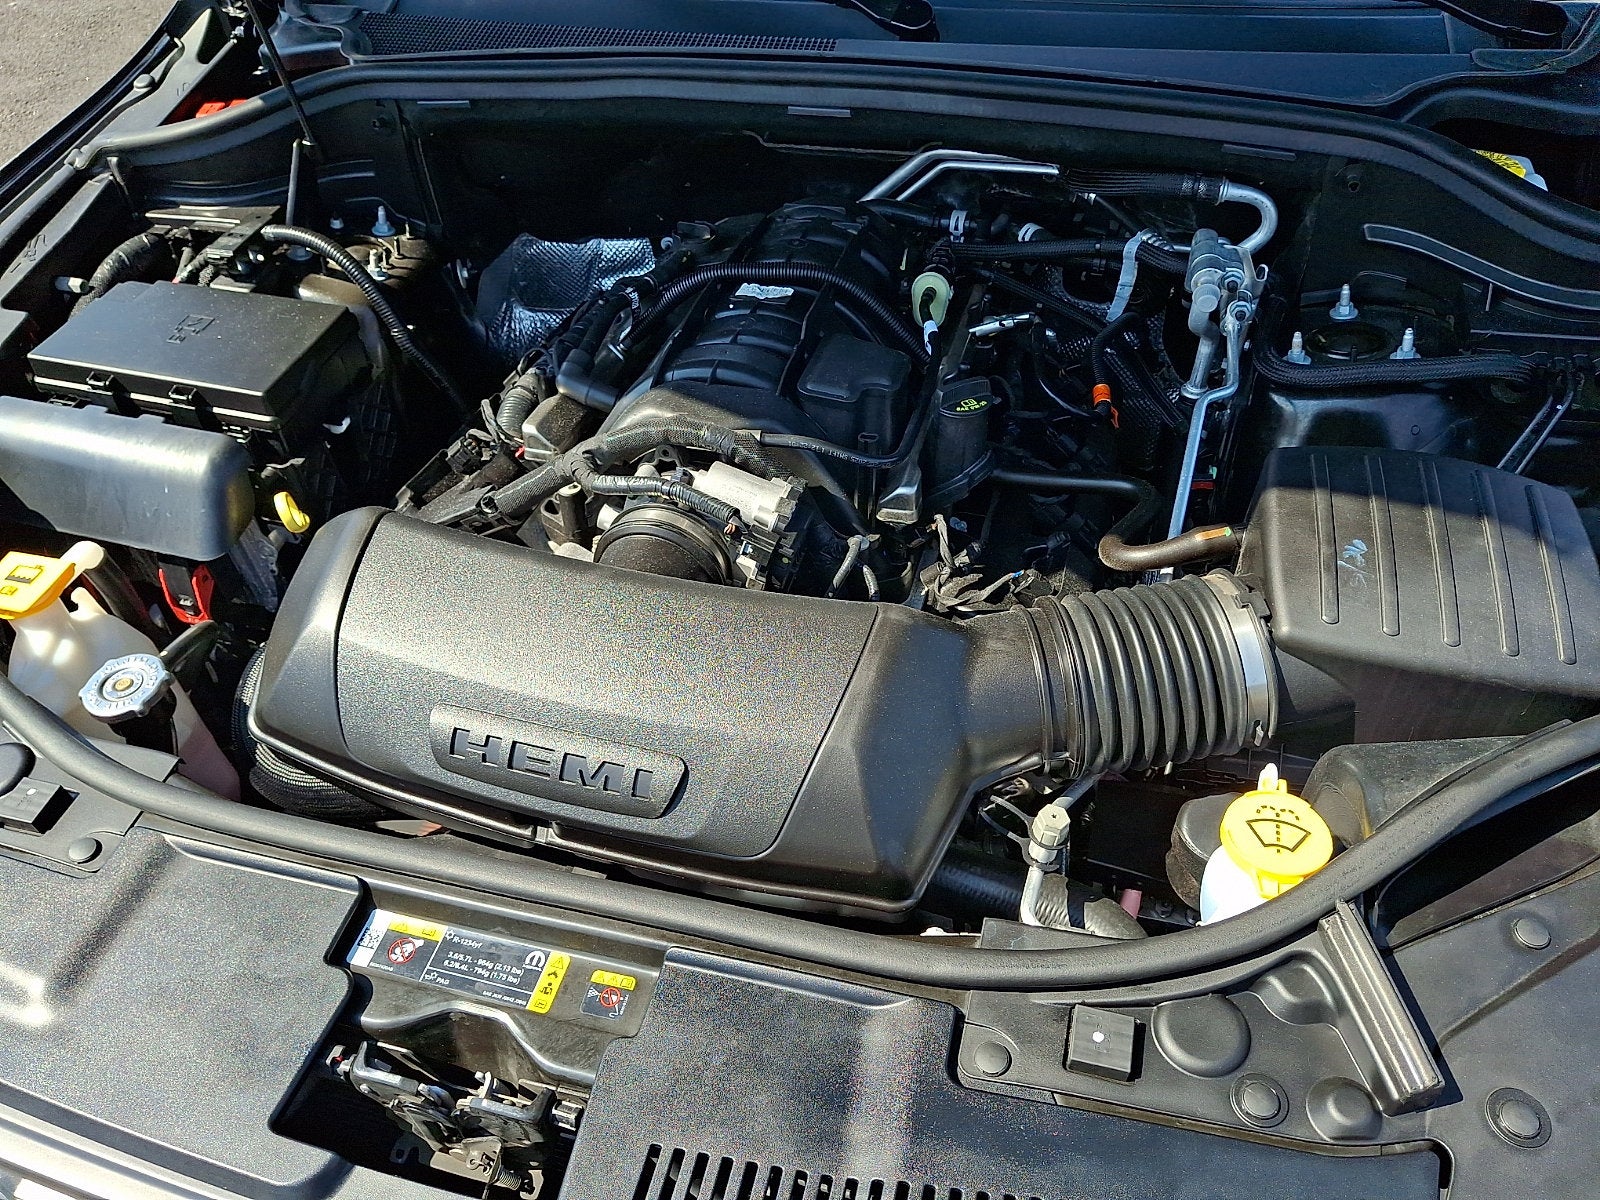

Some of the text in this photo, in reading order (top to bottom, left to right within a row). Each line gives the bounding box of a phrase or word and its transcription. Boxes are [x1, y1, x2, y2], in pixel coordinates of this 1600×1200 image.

[449, 727, 653, 800] HEMI
[452, 937, 482, 948] R-1234yf
[447, 951, 473, 963] 3.6/5.7L
[494, 962, 510, 972] (2.13
[511, 966, 525, 978] lbs)
[436, 977, 450, 985] PAG
[490, 971, 506, 981] (1.75
[507, 975, 521, 985] lbs)
